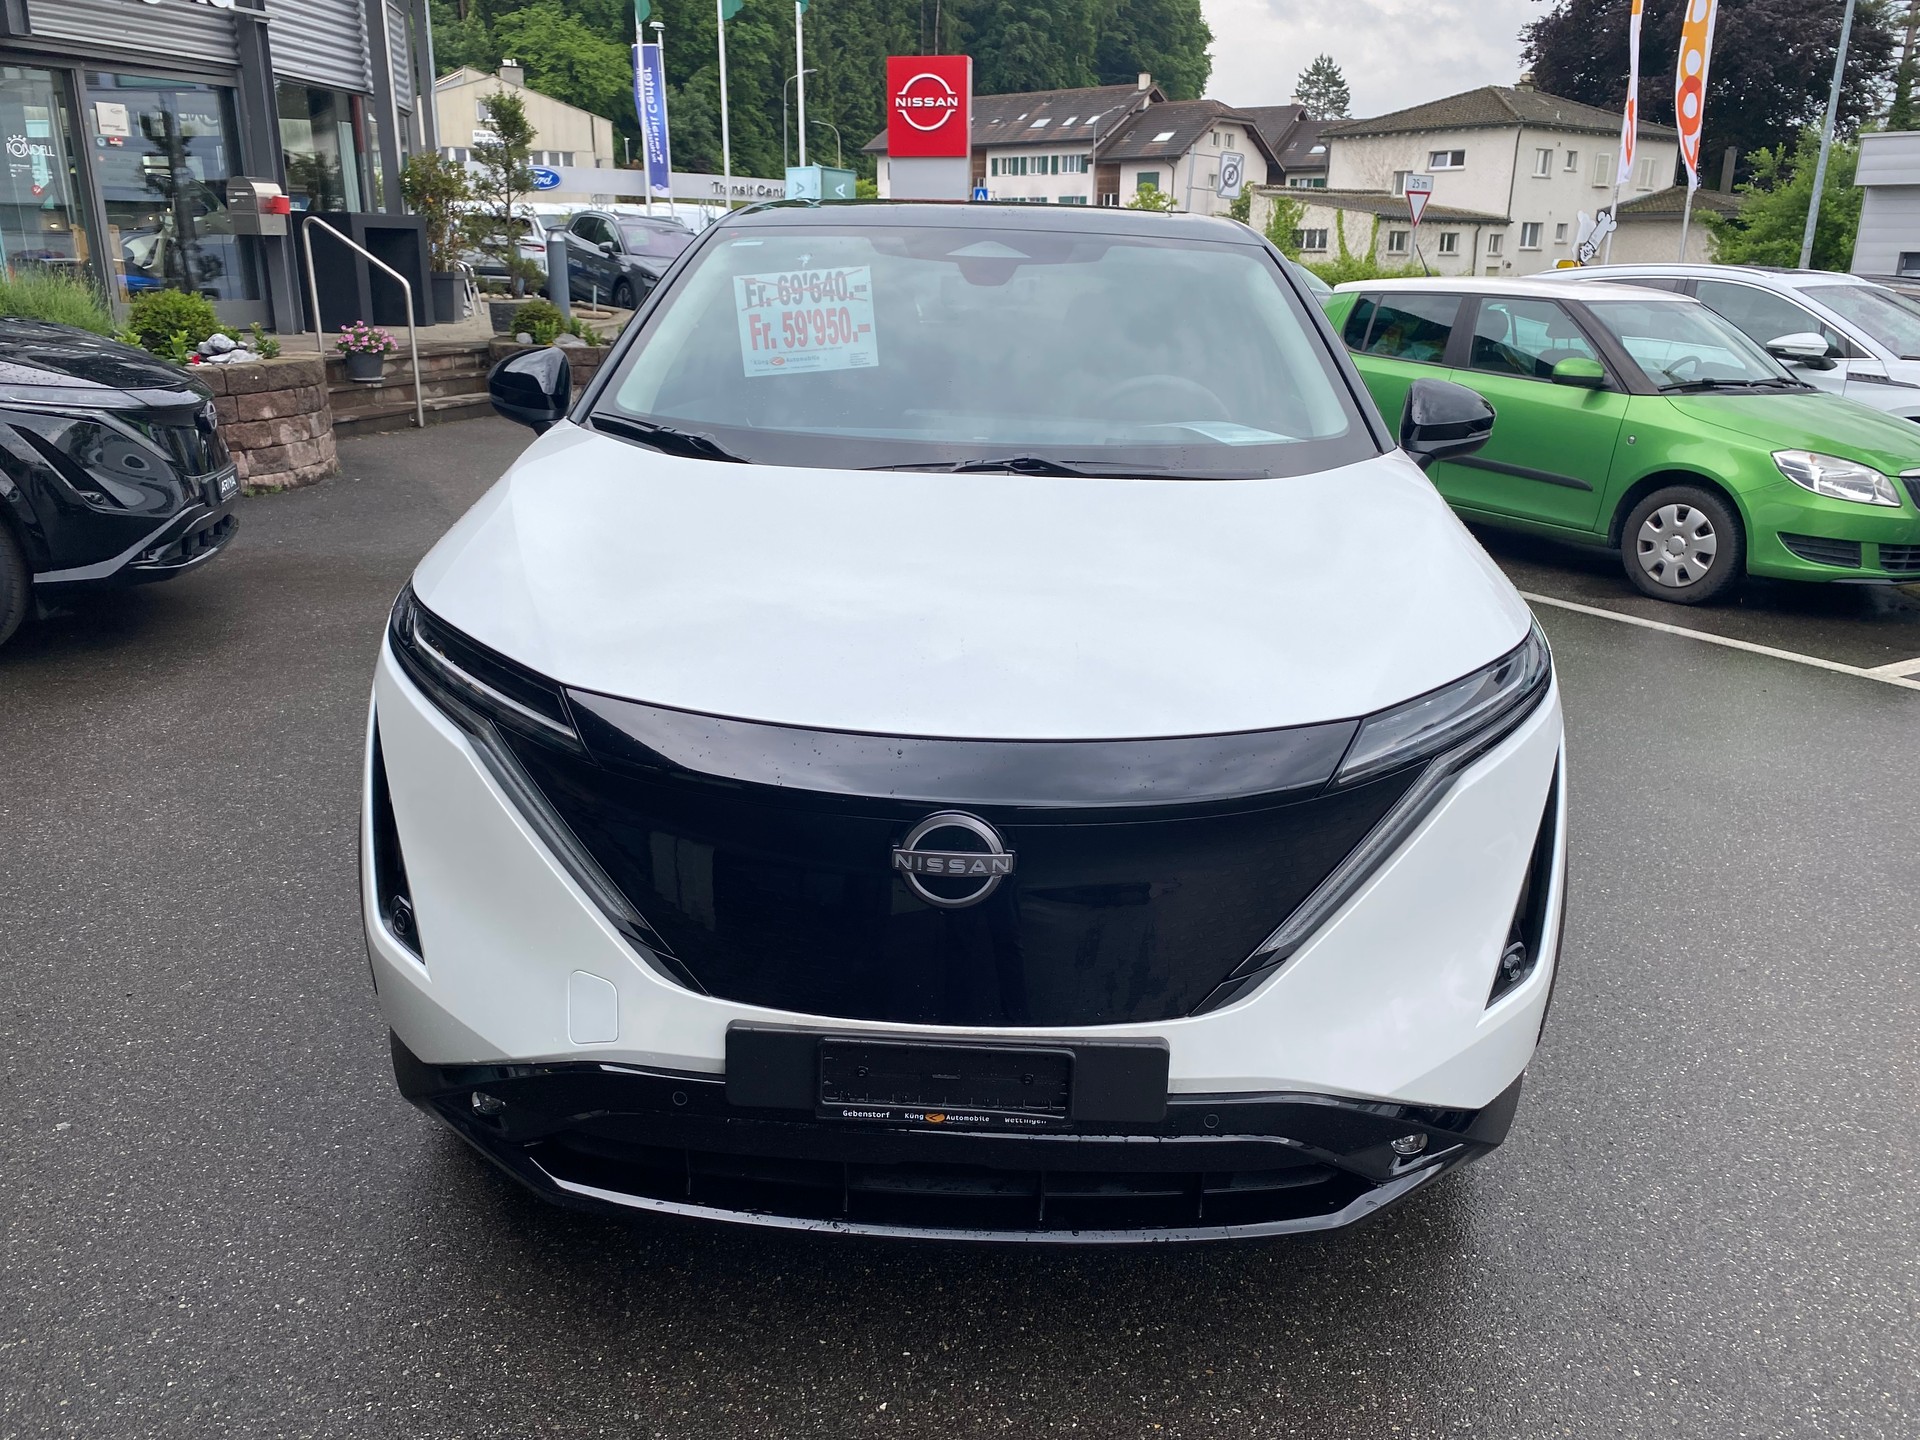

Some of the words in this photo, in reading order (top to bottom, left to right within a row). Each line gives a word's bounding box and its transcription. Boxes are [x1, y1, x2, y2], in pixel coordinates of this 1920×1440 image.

[895, 97, 958, 107] NISSAN
[6, 142, 55, 157] RONDELL
[1412, 178, 1420, 189] 25
[757, 185, 785, 199] Cent
[744, 278, 772, 308] Fr.
[749, 314, 777, 350] Fr.
[895, 854, 1010, 874] NISSAN
[842, 1109, 890, 1118] Gebenstorf
[904, 1112, 922, 1120] Küng
[945, 1114, 990, 1122] Automobile
